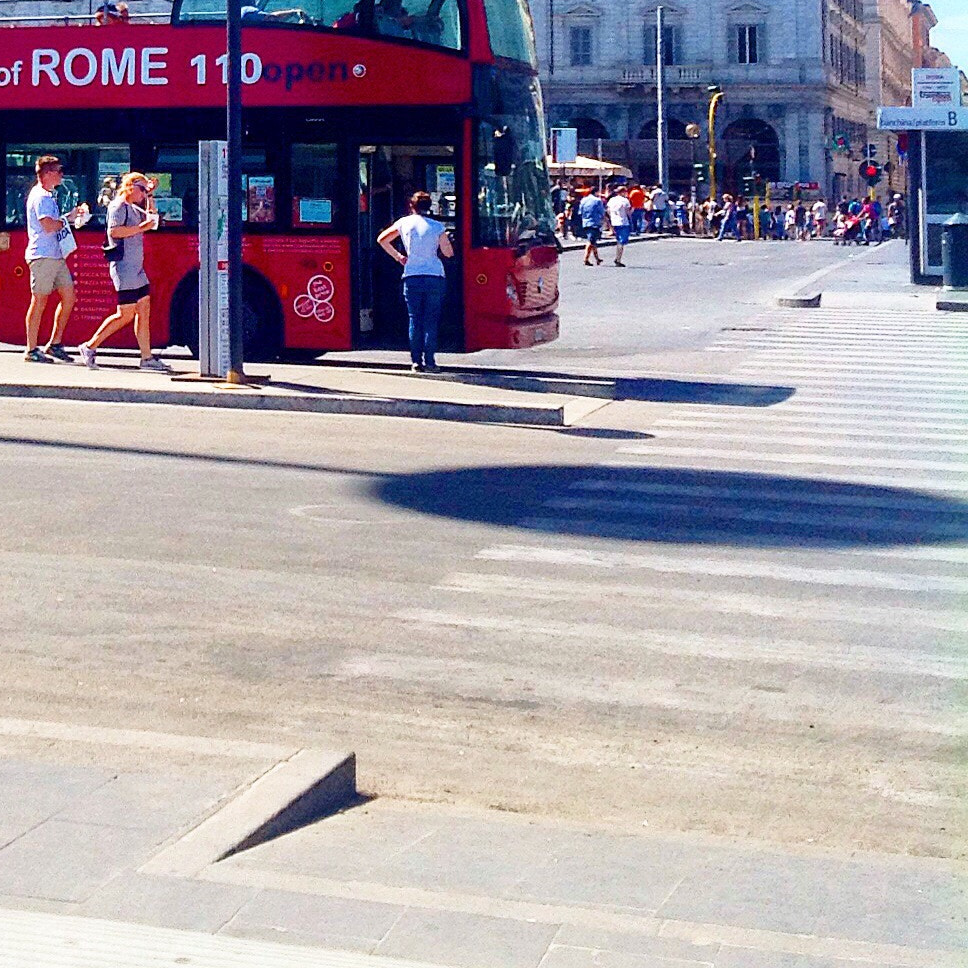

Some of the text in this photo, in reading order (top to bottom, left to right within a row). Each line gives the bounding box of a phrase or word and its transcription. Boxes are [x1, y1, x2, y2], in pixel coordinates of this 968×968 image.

[32, 47, 168, 86] ROME
[190, 52, 263, 85] 110
[948, 111, 958, 126] B
